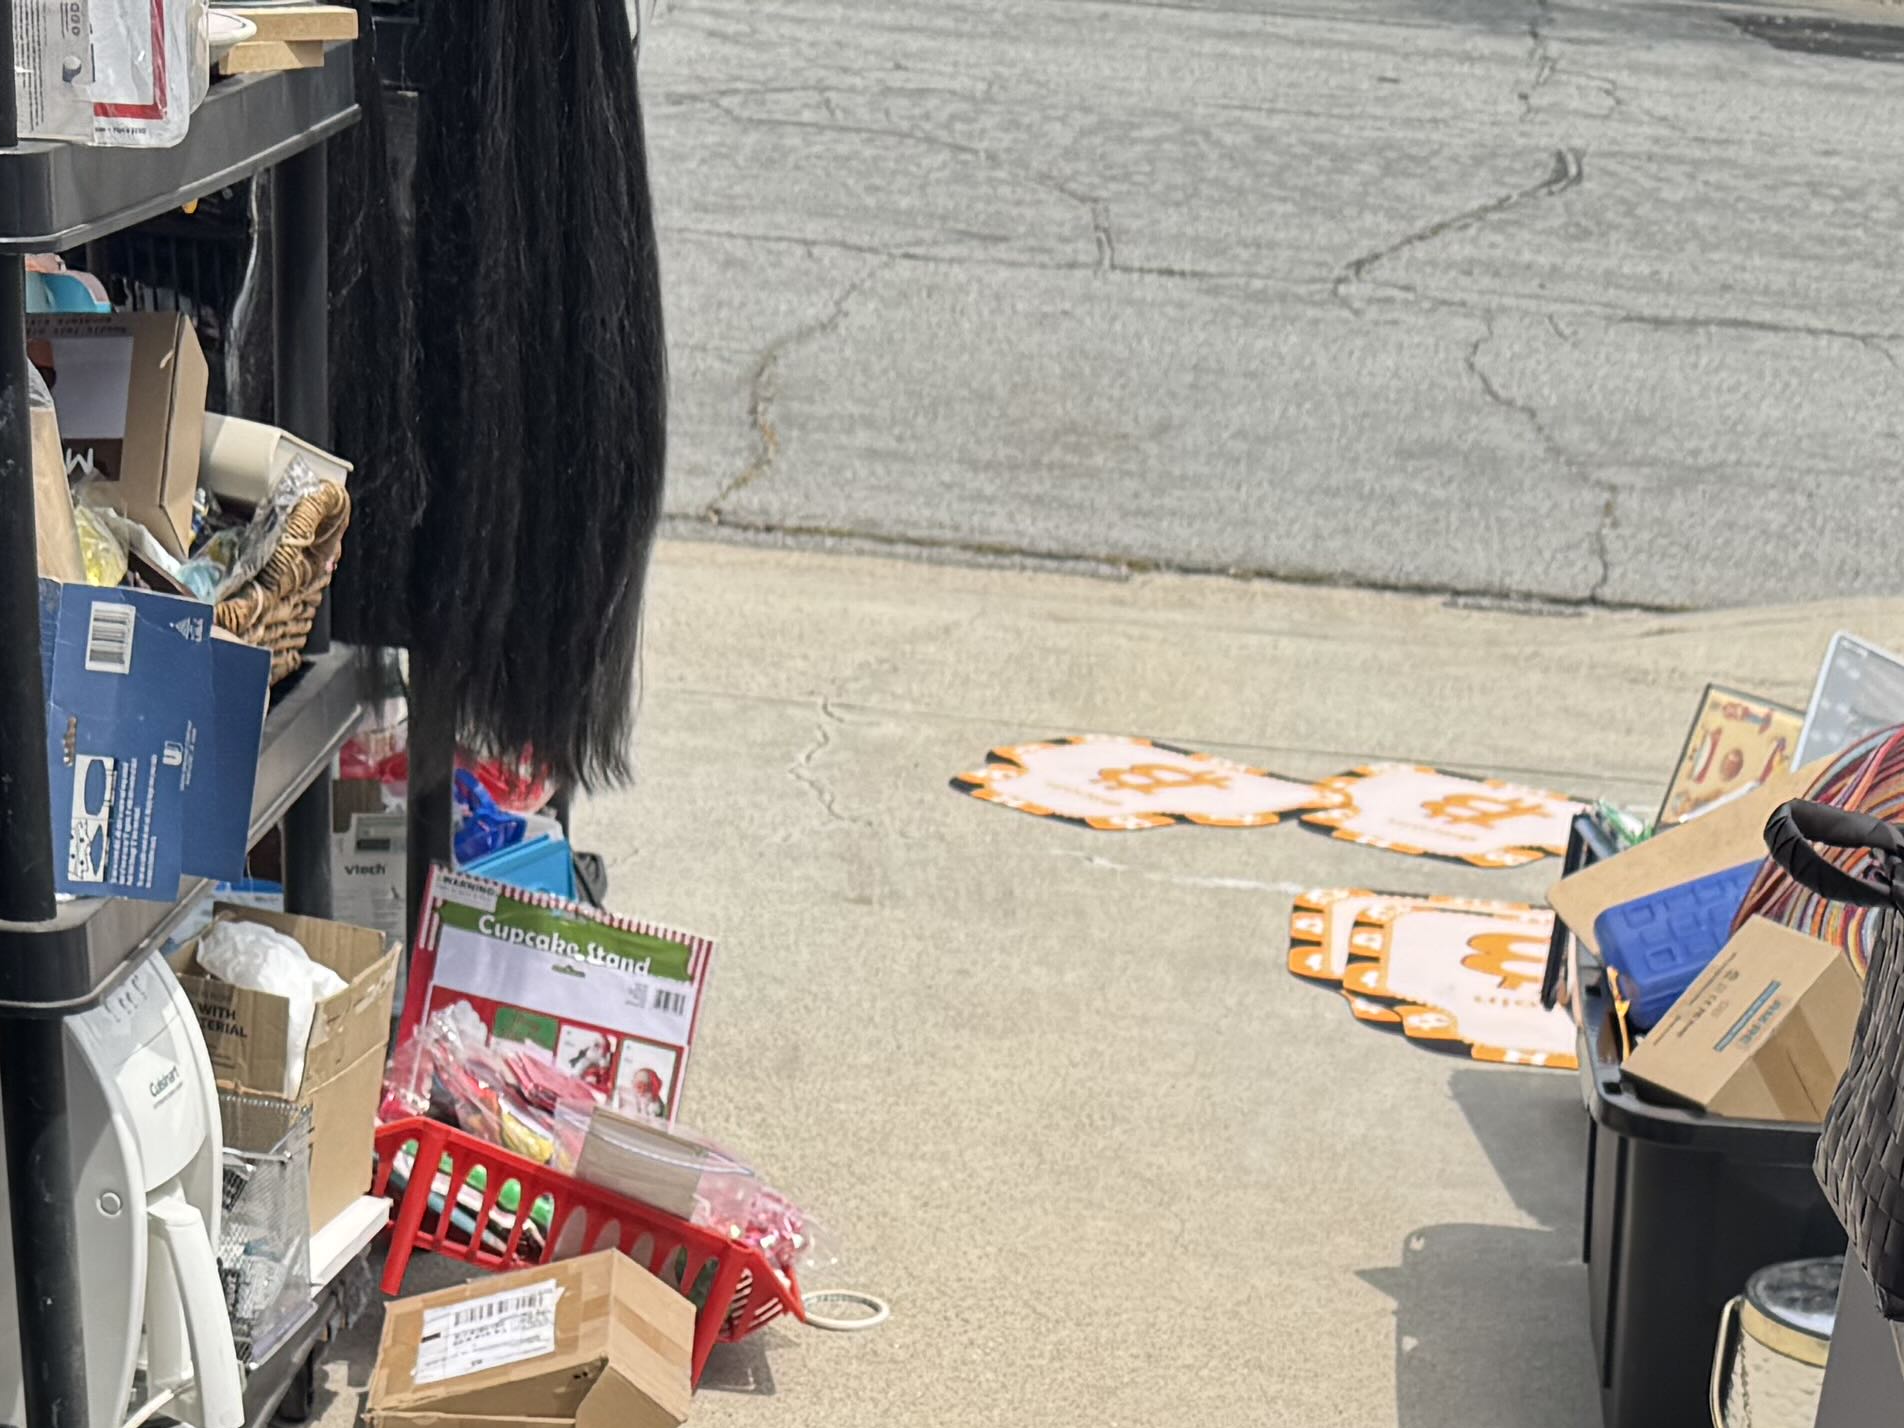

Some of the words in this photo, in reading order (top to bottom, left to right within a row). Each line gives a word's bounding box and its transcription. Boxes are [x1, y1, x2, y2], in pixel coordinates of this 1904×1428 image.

[478, 915, 584, 957] Cupcake
[586, 942, 650, 976] Stand
[199, 1005, 236, 1021] WITH
[200, 1019, 248, 1039] TERIAL
[149, 1064, 179, 1098] Cuisinart
